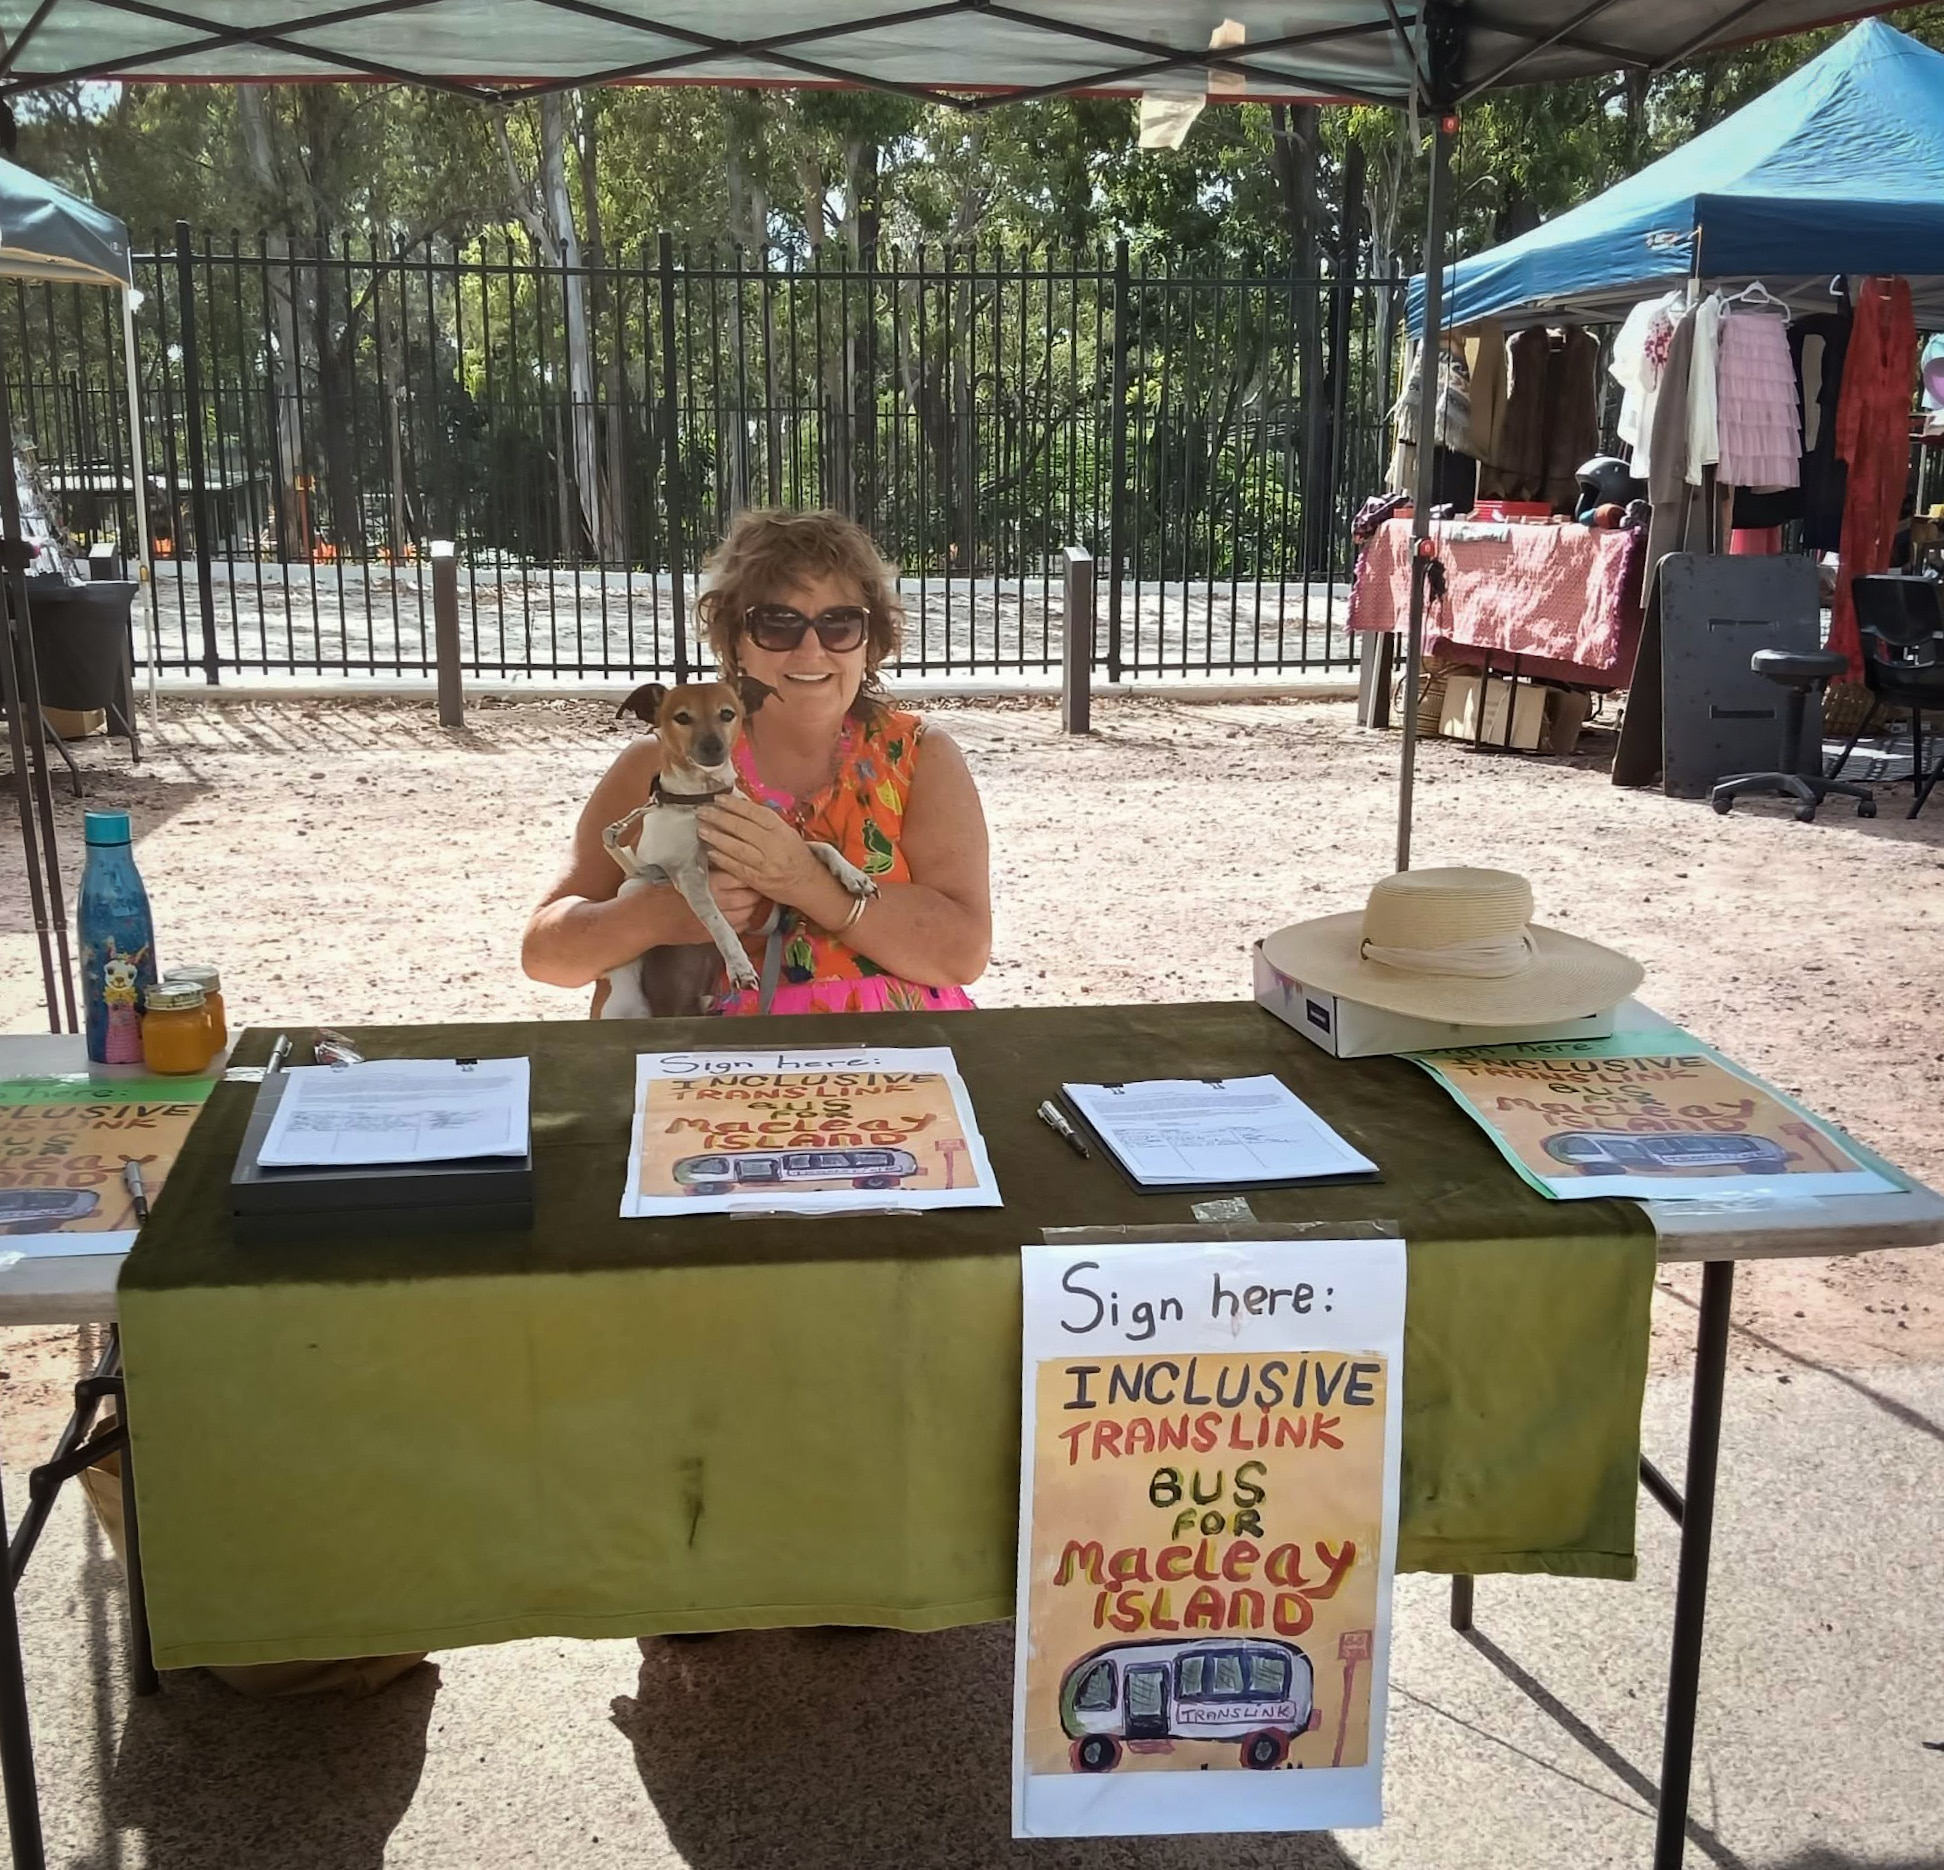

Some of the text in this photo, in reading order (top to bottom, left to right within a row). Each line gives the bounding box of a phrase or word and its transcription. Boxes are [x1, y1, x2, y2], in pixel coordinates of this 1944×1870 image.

[660, 1055, 882, 1074] Sign here:
[1450, 1055, 1708, 1076] INCLUSIVE
[671, 1073, 938, 1091] INCLUSIVE
[1455, 1065, 1701, 1085] TRANSLINK
[674, 1084, 915, 1101] TRANSLINK
[747, 1098, 852, 1112] BUS
[1542, 1112, 1748, 1132] ISLAND
[704, 1132, 908, 1149] ISLAND
[1060, 1261, 1335, 1342] Sign here:
[1063, 1351, 1383, 1410] INCLUSIVE
[1057, 1407, 1345, 1466] TRANSLINK
[1149, 1460, 1267, 1509] BUS
[1171, 1508, 1265, 1541] FOR
[1092, 1581, 1316, 1637] ISLAND
[1181, 1702, 1293, 1722] TRANSLINK
